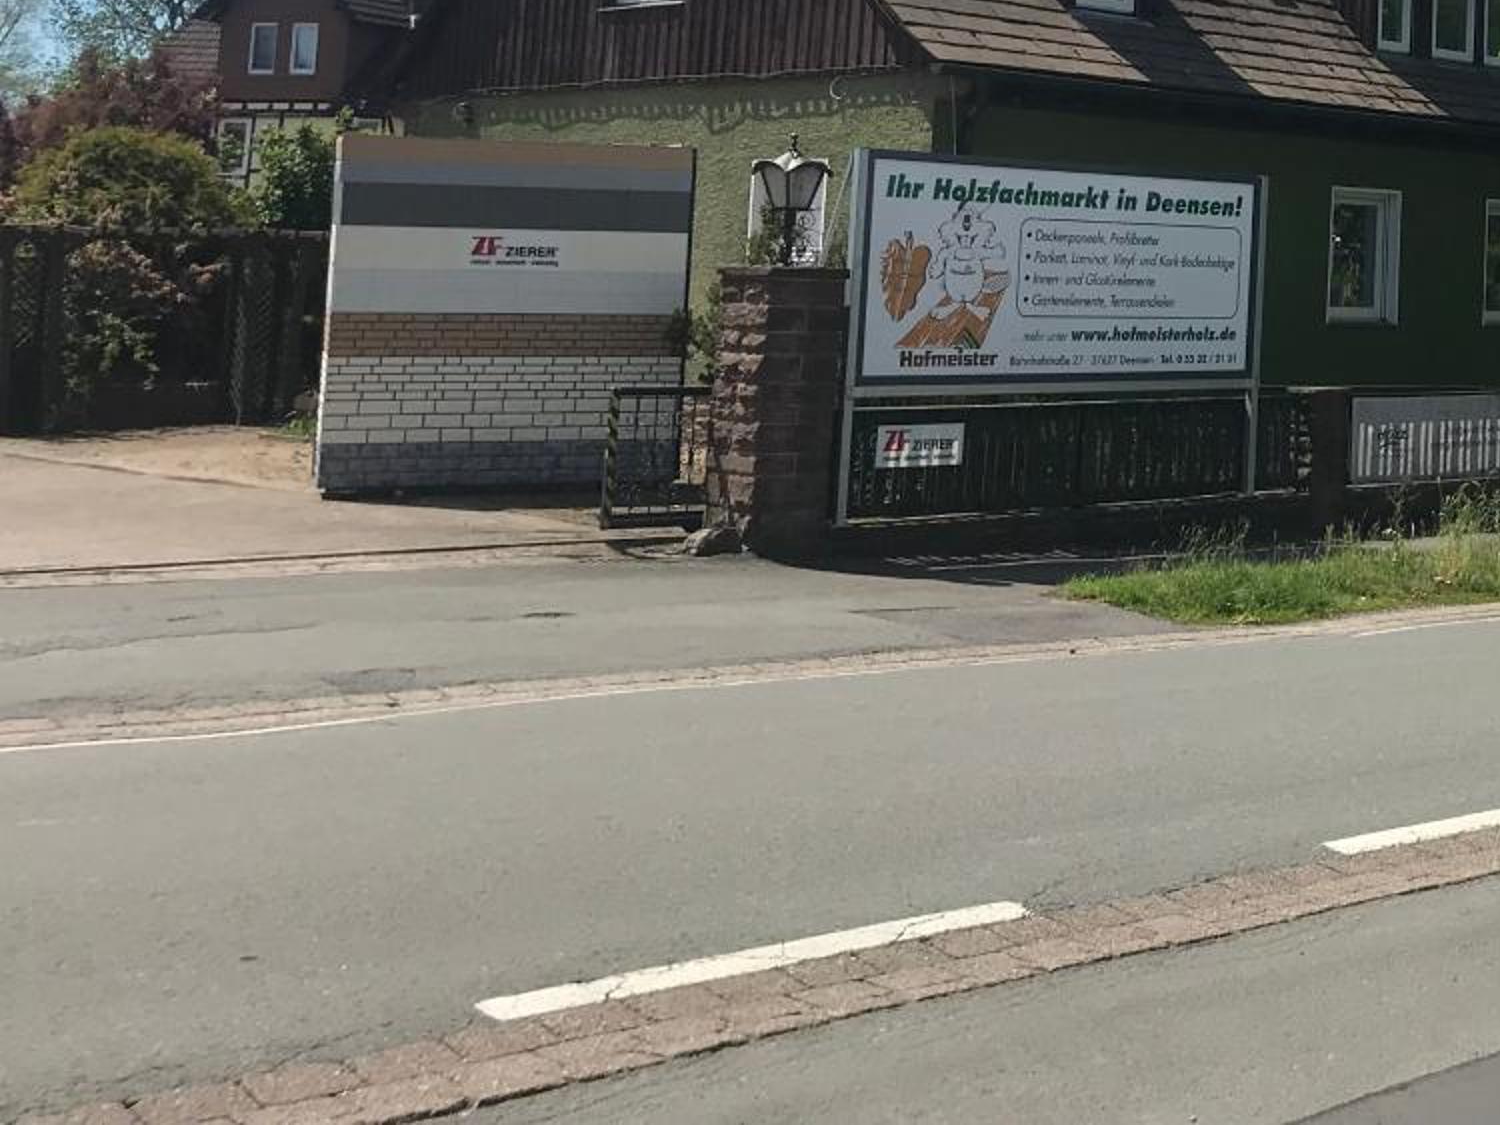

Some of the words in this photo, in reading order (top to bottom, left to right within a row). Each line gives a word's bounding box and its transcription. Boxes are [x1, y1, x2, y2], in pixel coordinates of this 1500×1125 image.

[886, 174, 924, 200] Ihr
[933, 178, 1109, 210] Holzfachmarkt
[1117, 188, 1138, 212] in
[1146, 191, 1243, 217] Deensen!
[505, 246, 556, 258] ZIERER
[1071, 326, 1237, 342] www.hofmeisterholz.de
[900, 346, 998, 368] Hofmeister
